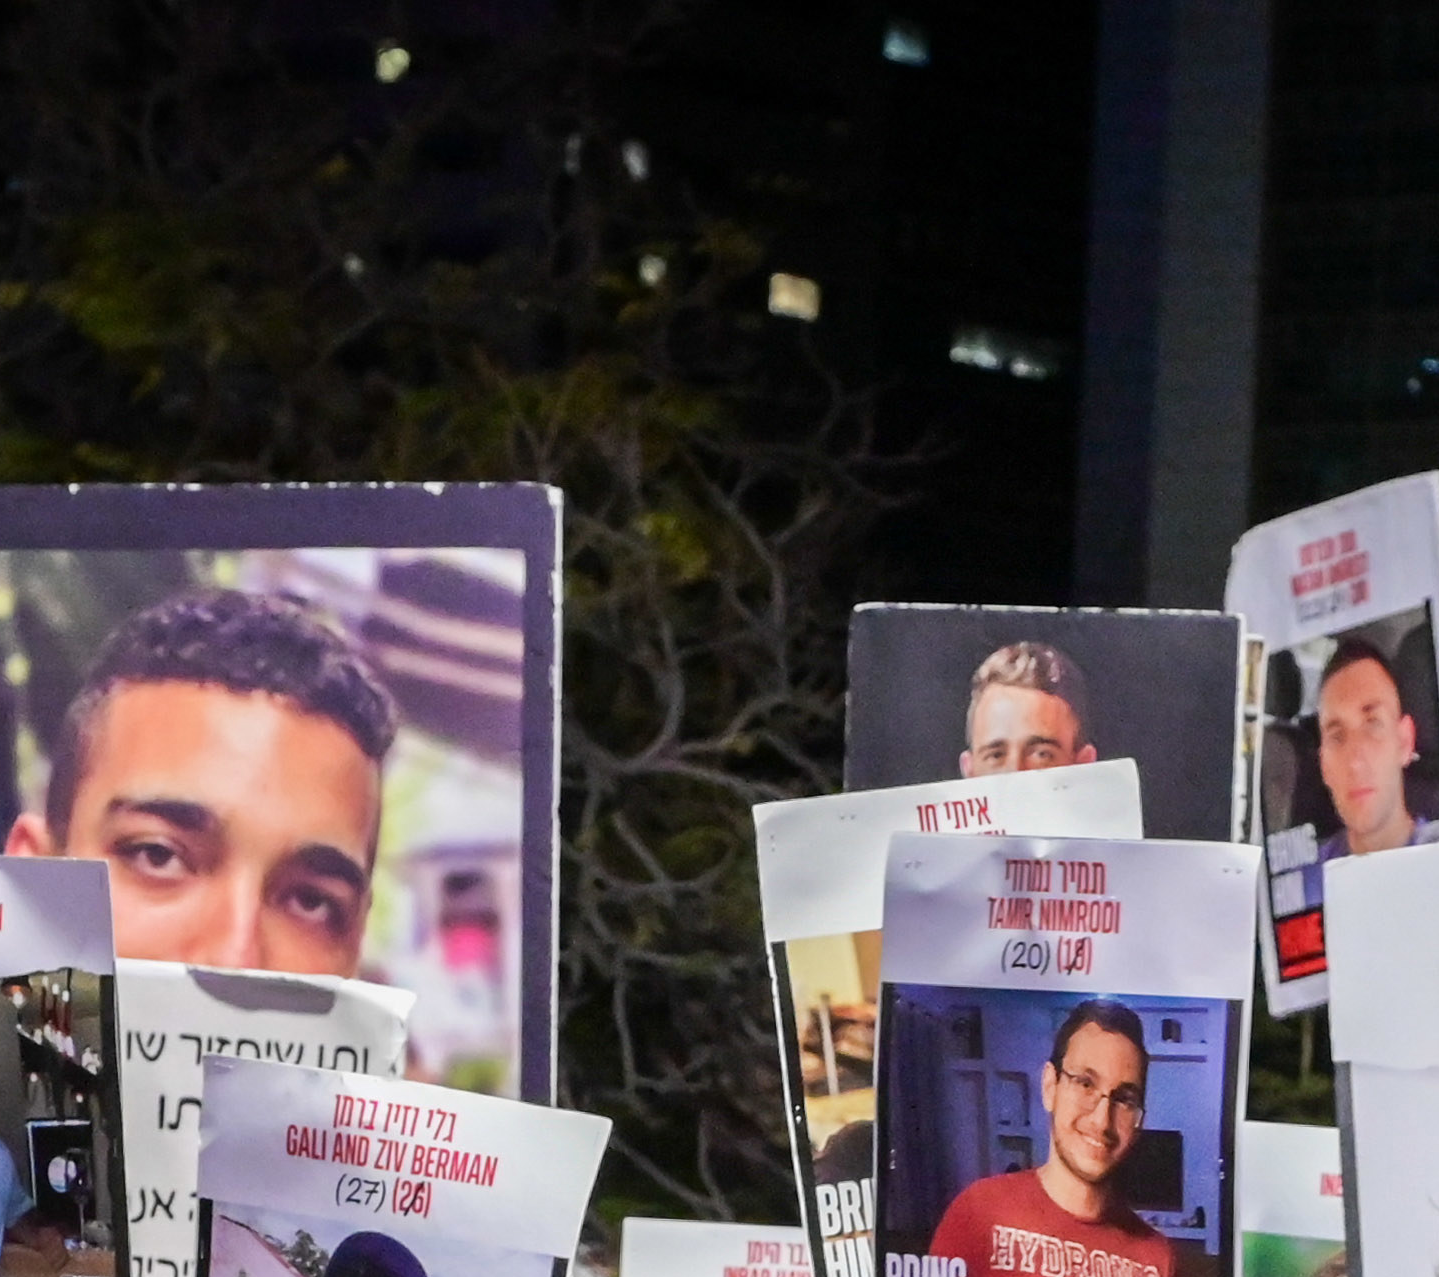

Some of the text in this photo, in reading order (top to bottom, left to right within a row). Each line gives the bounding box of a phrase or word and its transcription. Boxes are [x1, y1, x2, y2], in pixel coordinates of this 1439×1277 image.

[916, 796, 992, 834] איתי חן
[286, 1126, 497, 1187] GALI AND ZIV BERMAN
